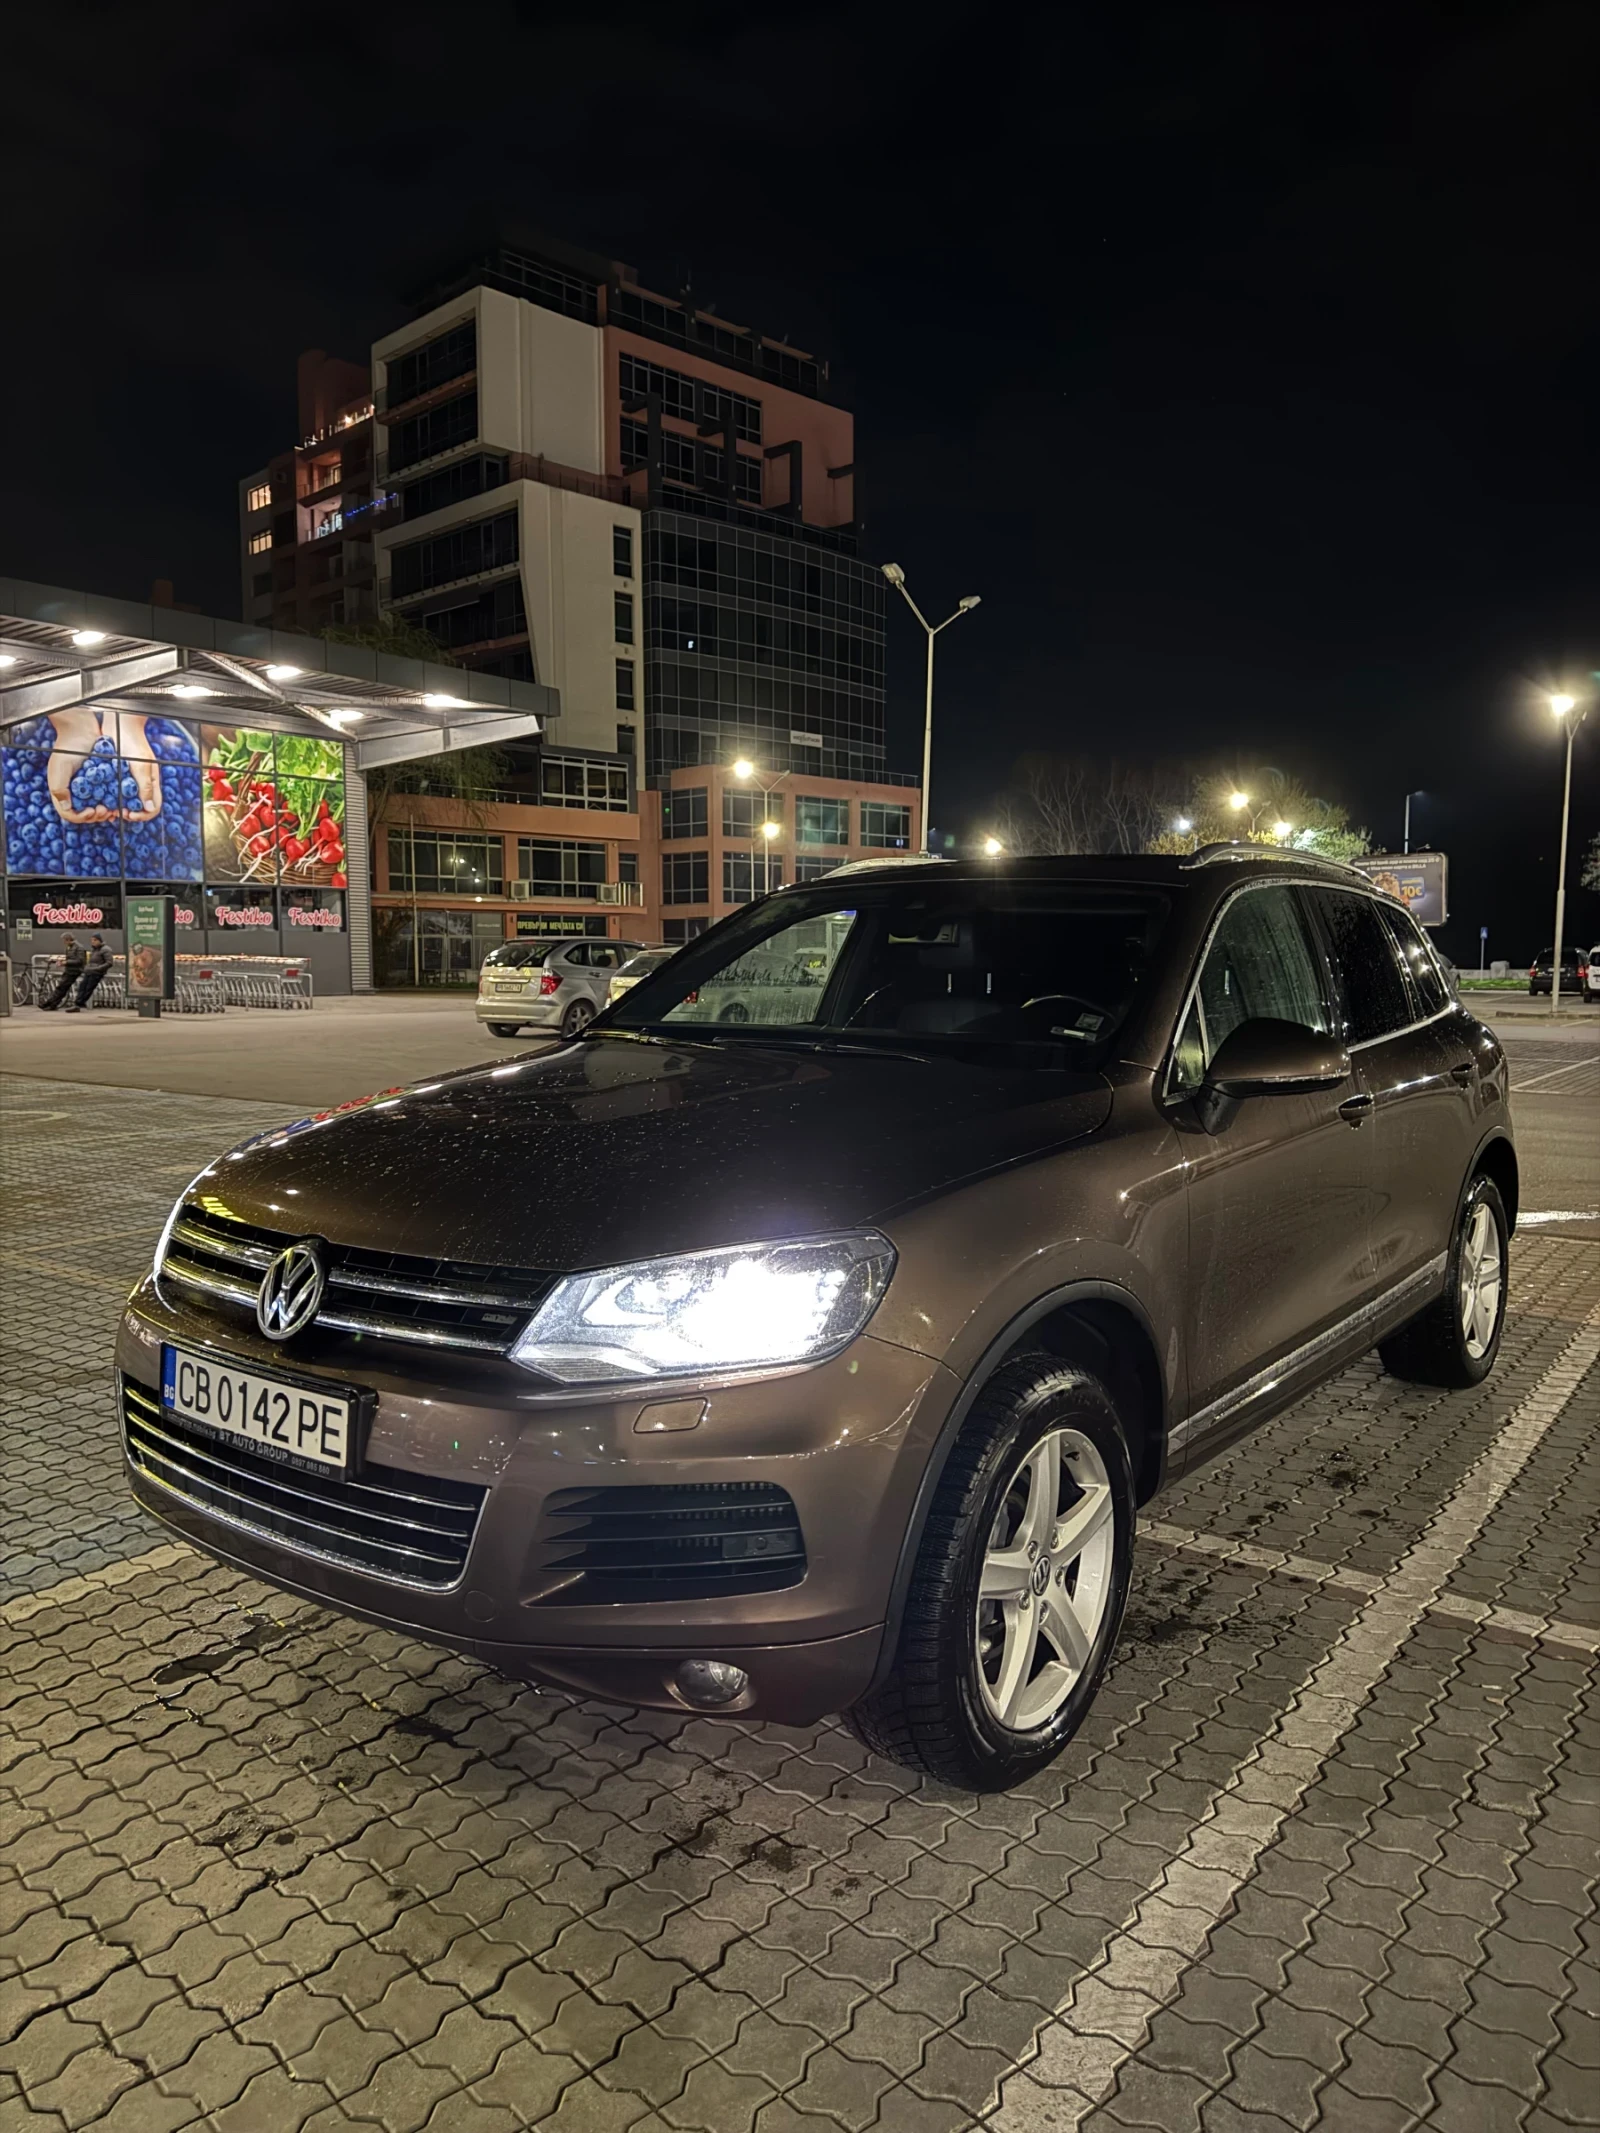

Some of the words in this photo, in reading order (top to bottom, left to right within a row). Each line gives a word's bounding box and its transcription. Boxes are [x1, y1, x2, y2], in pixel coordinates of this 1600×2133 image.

[33, 903, 103, 925] Festiko
[215, 905, 273, 926] Festiko
[288, 907, 342, 927] Festiko
[164, 1385, 175, 1400] BG
[219, 1430, 231, 1442] BT
[232, 1434, 255, 1452] AUTO
[257, 1443, 288, 1461] GROUP
